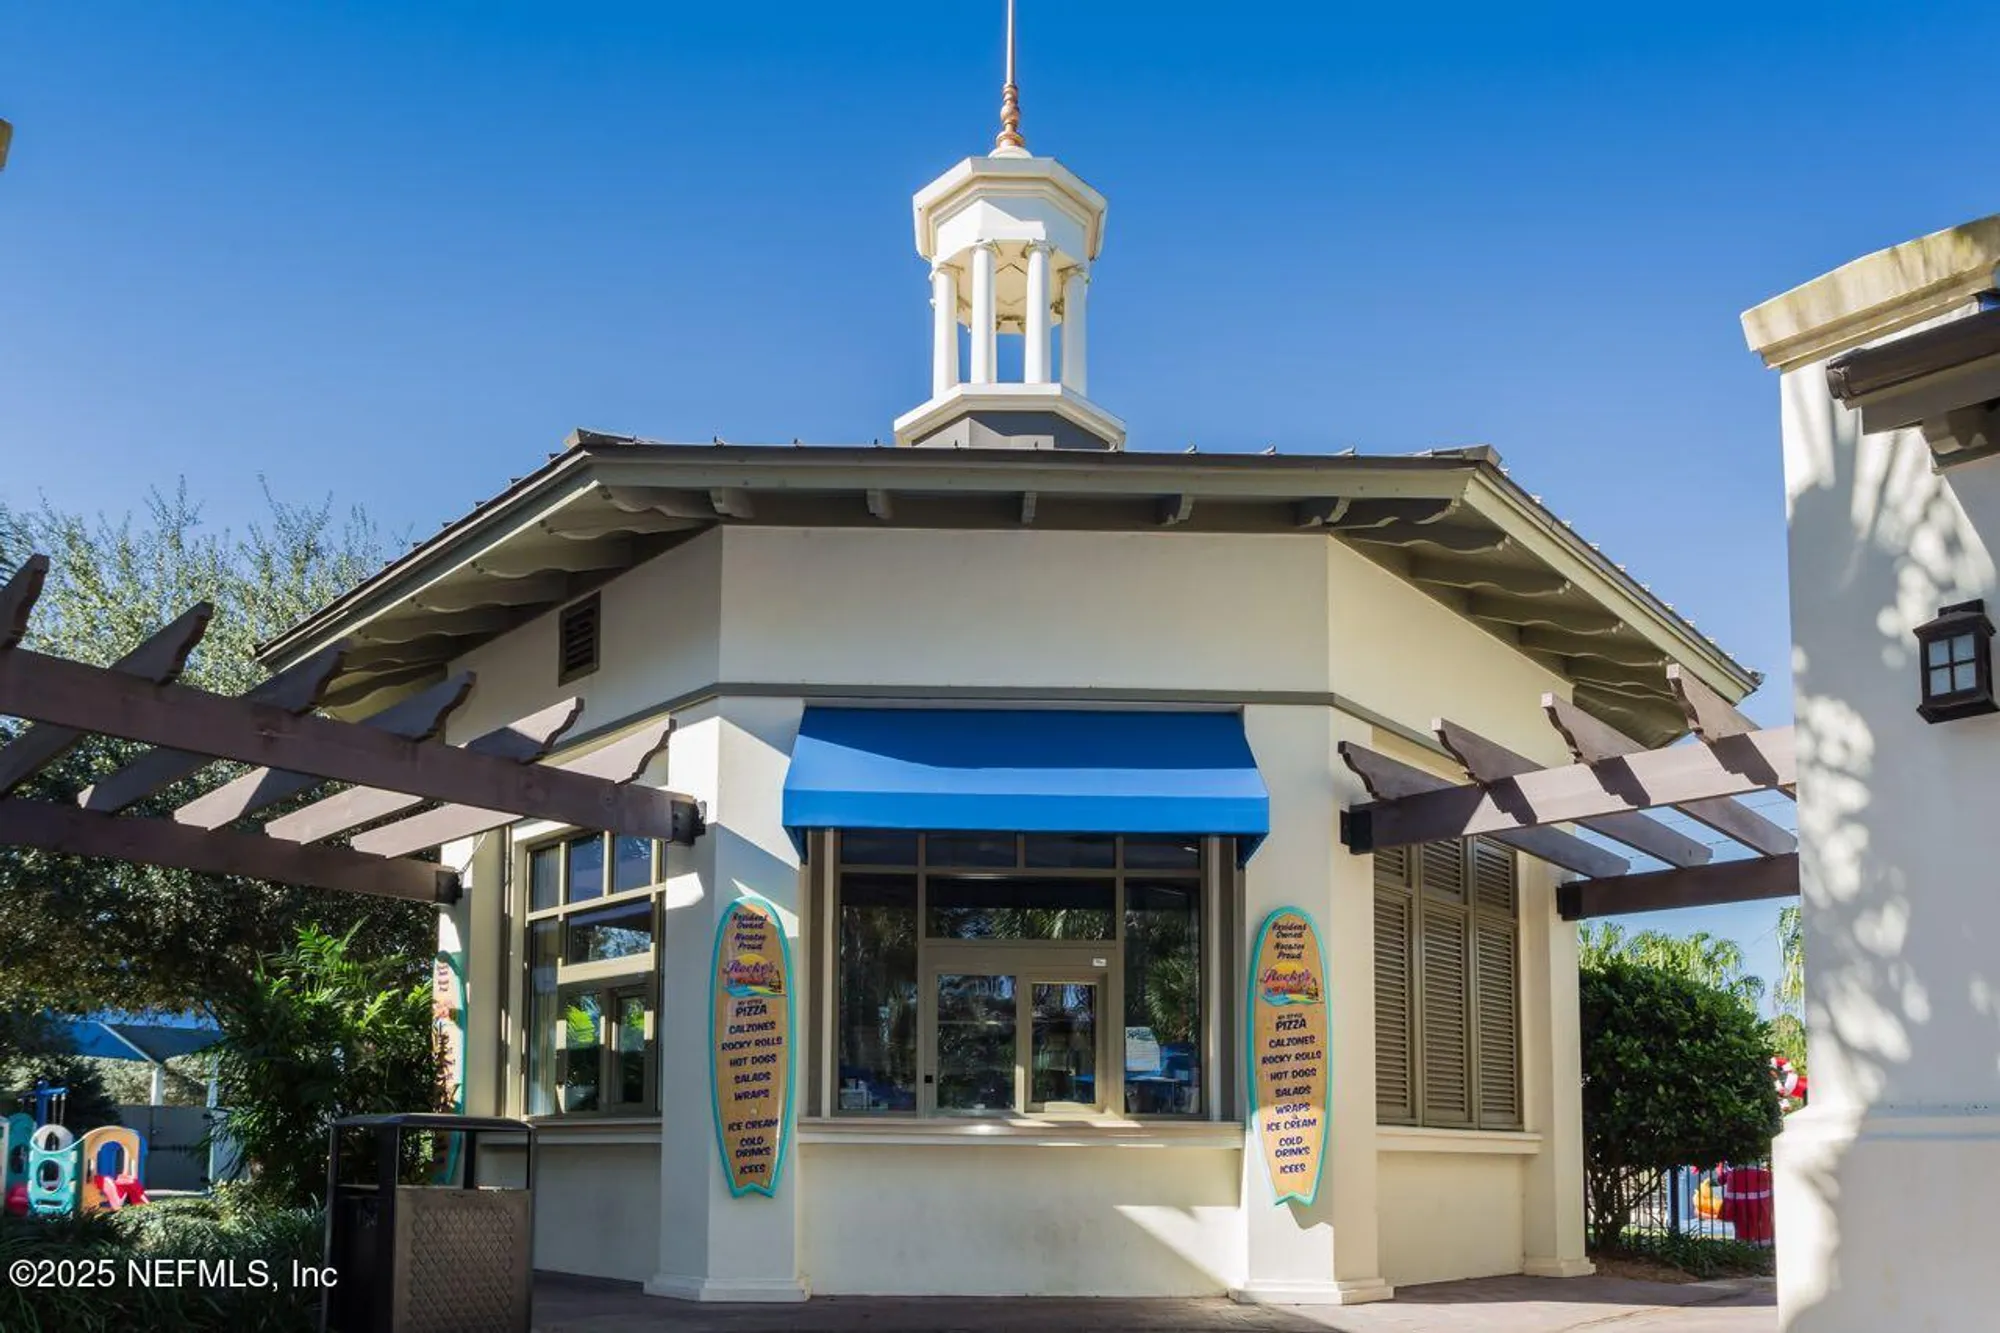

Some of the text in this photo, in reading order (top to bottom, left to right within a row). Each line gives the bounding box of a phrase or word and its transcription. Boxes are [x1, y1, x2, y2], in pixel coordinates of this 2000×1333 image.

[1277, 951, 1302, 960] Proud
[735, 1004, 767, 1017] PIZZA
[729, 1020, 776, 1034] CALZONES
[1276, 1018, 1306, 1031] PIZZA
[722, 1036, 782, 1051] ROCKY ROLLS
[1269, 1035, 1315, 1048] CALZONES
[730, 1054, 777, 1067] HOT DOGS
[1262, 1051, 1321, 1065] ROCKY ROLLS
[734, 1072, 771, 1084] SALADS
[1270, 1068, 1317, 1080] HOT DOGS
[734, 1089, 769, 1101] WRAPS
[1275, 1086, 1311, 1098] SALADS
[1275, 1102, 1310, 1114] WRAPS
[728, 1118, 778, 1132] ICE CREAM
[1267, 1119, 1317, 1132] ICE CREAM
[740, 1136, 763, 1147] COLD
[1279, 1136, 1303, 1147] COLD
[736, 1147, 771, 1158] DRINKS
[1275, 1146, 1310, 1158] DRINKS
[1280, 1163, 1306, 1174] ICEES
